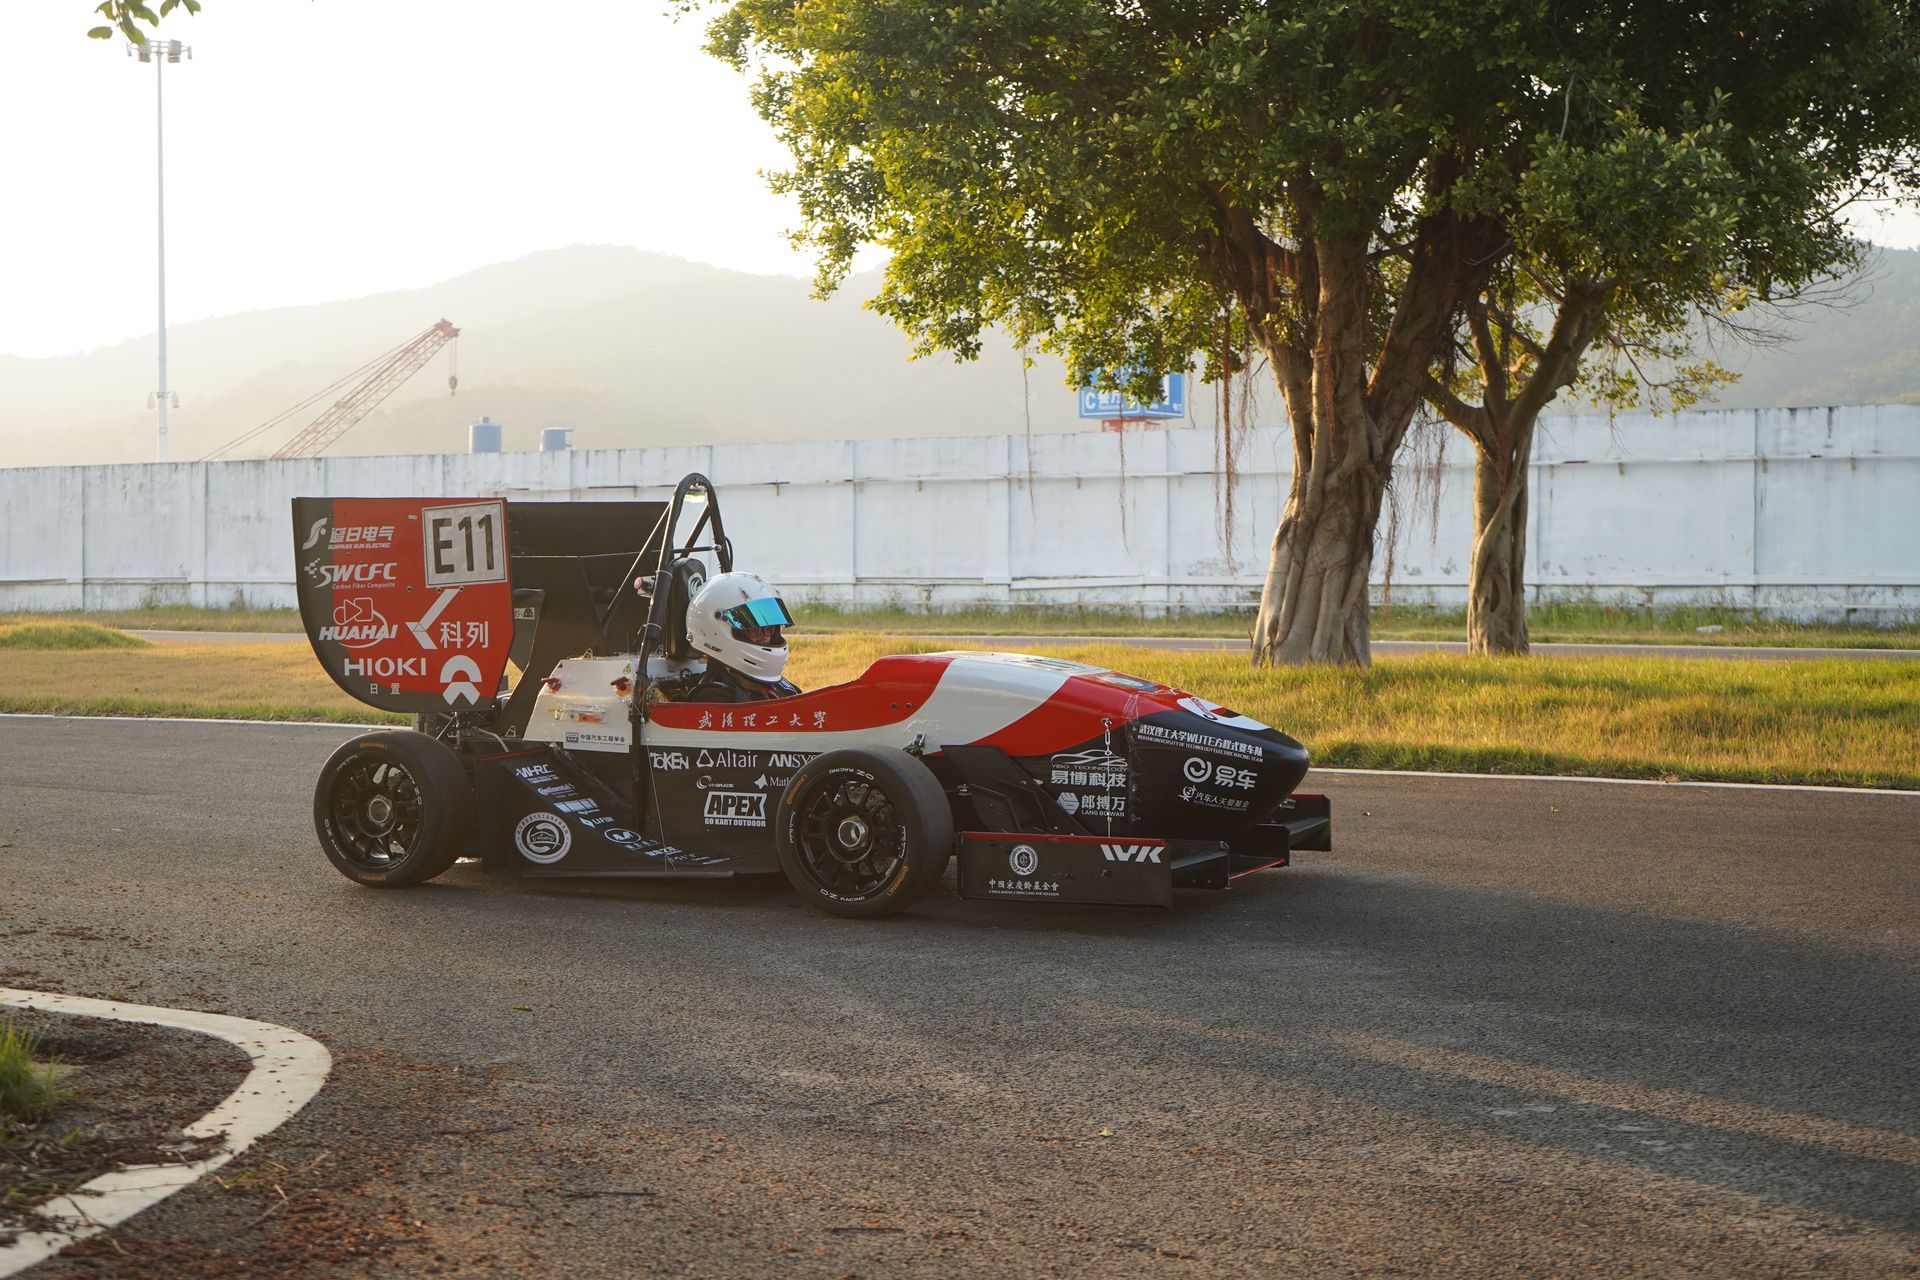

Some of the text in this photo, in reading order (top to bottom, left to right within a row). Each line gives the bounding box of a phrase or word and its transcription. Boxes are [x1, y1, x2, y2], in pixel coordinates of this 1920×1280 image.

[432, 514, 495, 574] E11
[314, 562, 398, 589] SWCFC
[318, 624, 398, 641] HUAHAI
[440, 621, 489, 648] 科列
[343, 657, 427, 676] HIOKI
[716, 751, 758, 768] Altair
[768, 753, 817, 768] ANSY
[857, 769, 875, 781] OZ
[1051, 770, 1127, 787] 易博科技
[1215, 765, 1258, 790] 易车
[706, 794, 764, 817] APEX
[715, 818, 732, 826] KART
[733, 819, 766, 827] OUTDOOR
[820, 888, 838, 900] OZ
